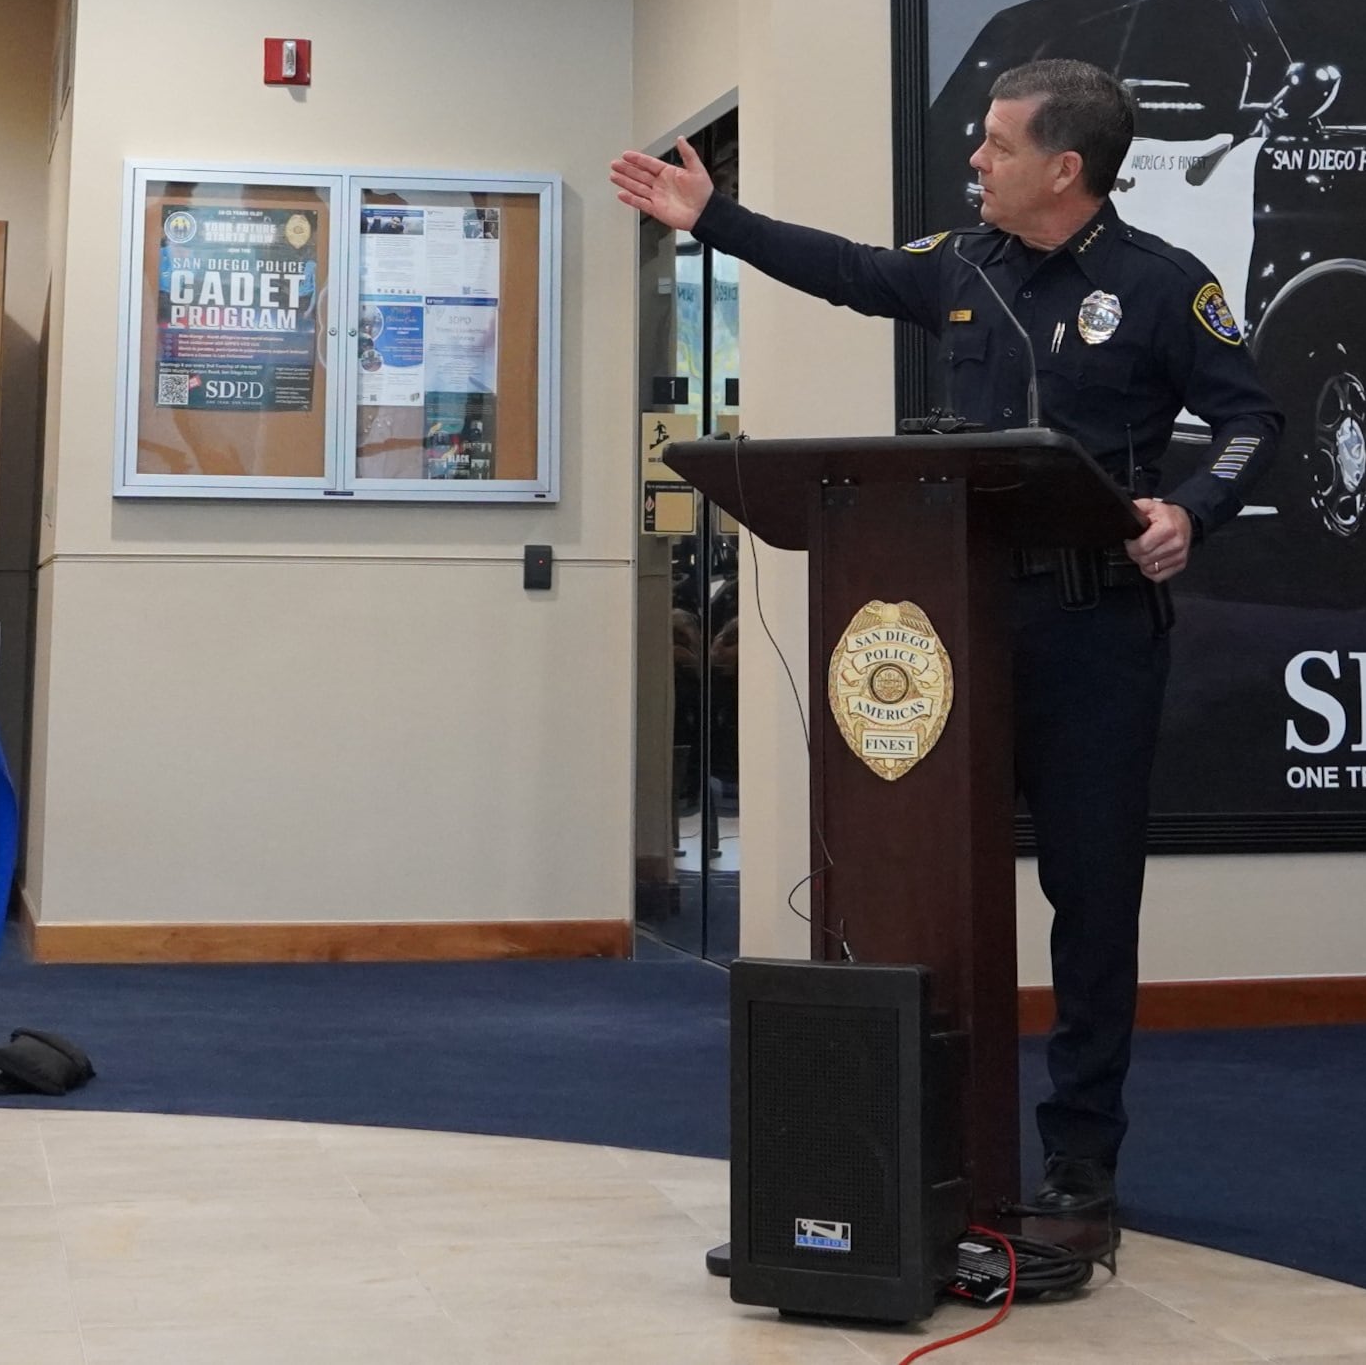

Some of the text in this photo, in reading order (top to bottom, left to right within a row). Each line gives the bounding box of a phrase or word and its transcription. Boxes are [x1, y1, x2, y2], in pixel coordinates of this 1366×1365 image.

[1178, 155, 1206, 170] FINEST
[1272, 149, 1303, 170] SAN
[1308, 149, 1356, 171] DIEGO
[204, 221, 277, 234] YOUR FUTURE
[172, 258, 306, 274] SAN DIEGO POLICE
[170, 270, 307, 308] CADET
[170, 305, 297, 330] PROGRAM
[205, 380, 264, 399] SDPD
[669, 380, 676, 400] 1
[856, 630, 929, 650] SAN DIEGO
[865, 649, 917, 664] POLICE
[865, 739, 914, 751] FINEST
[1286, 766, 1339, 788] ONE
